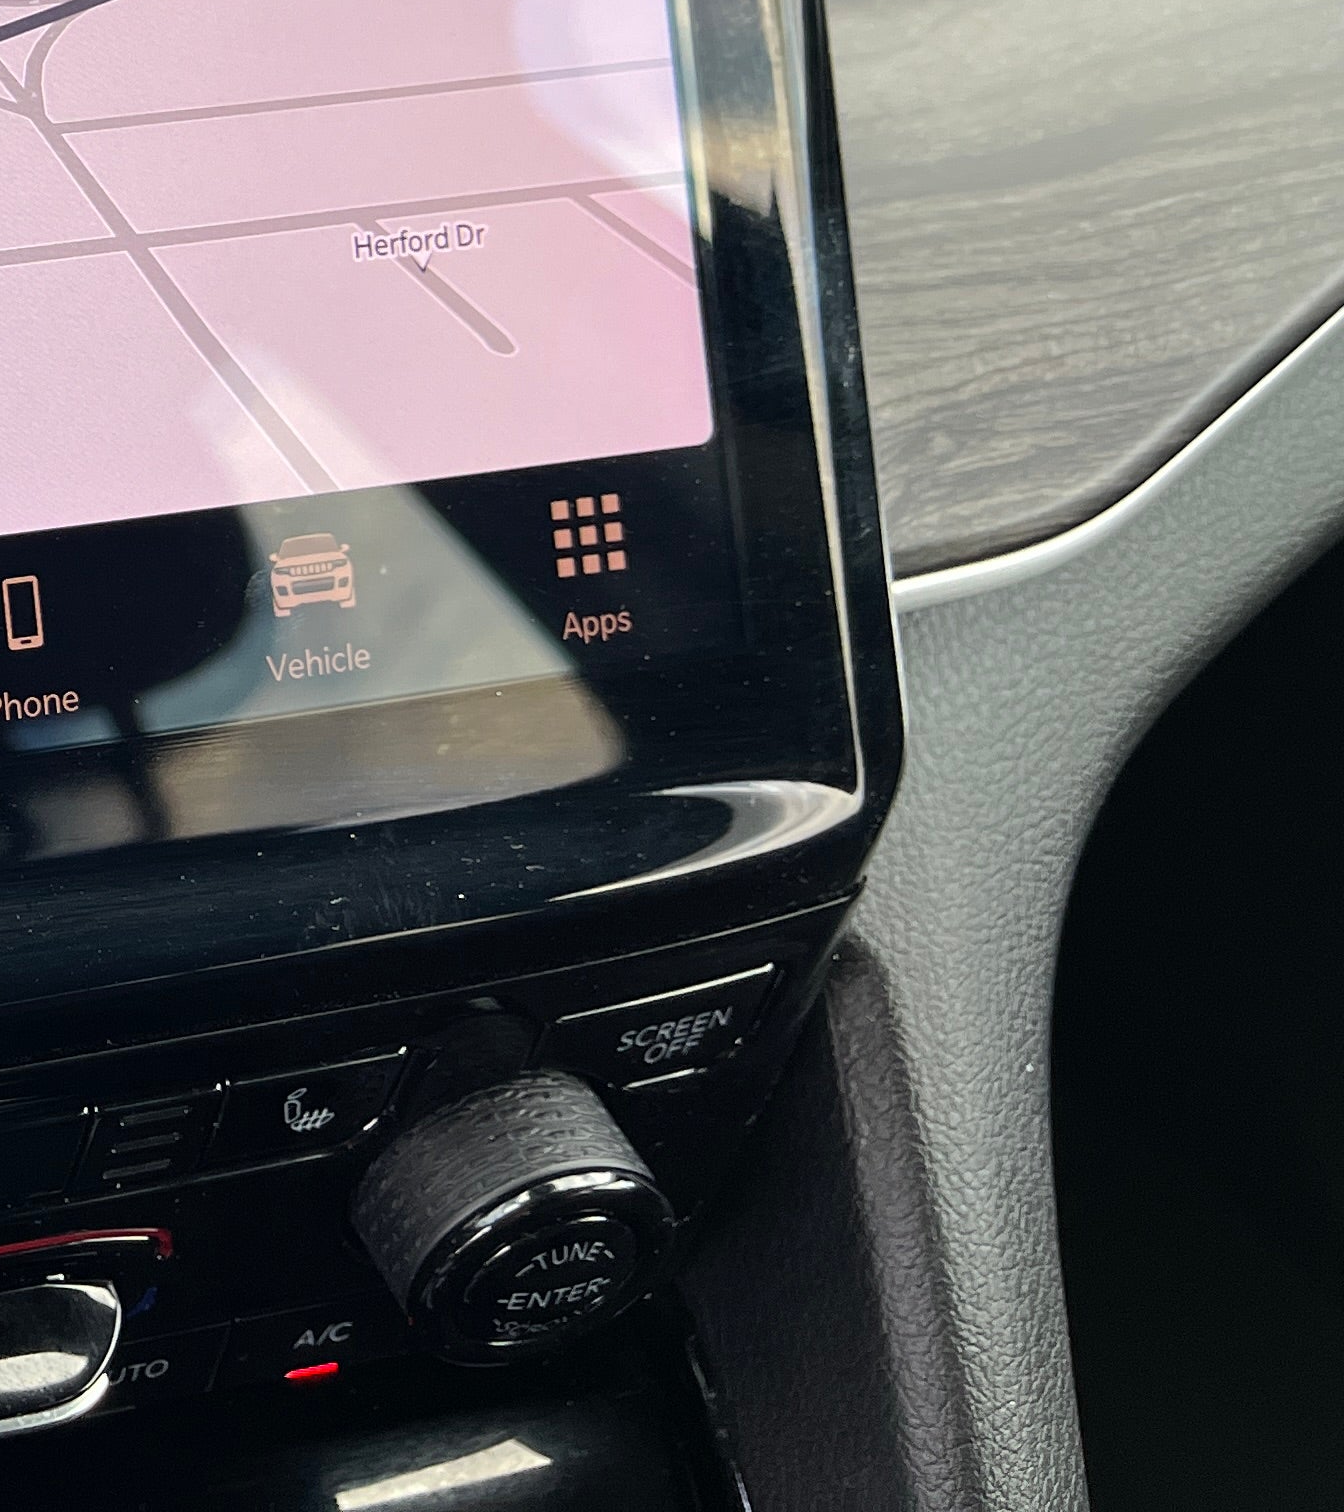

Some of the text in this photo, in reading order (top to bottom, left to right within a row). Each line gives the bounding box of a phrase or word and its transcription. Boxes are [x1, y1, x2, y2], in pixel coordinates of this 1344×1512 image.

[354, 222, 484, 259] Herford Dr
[562, 610, 633, 645] Apps
[266, 643, 372, 682] Vehicle
[616, 1005, 733, 1052] SCREEN
[644, 1033, 703, 1065] OFF
[292, 1322, 353, 1349] A/C
[110, 1359, 169, 1386] UTO
